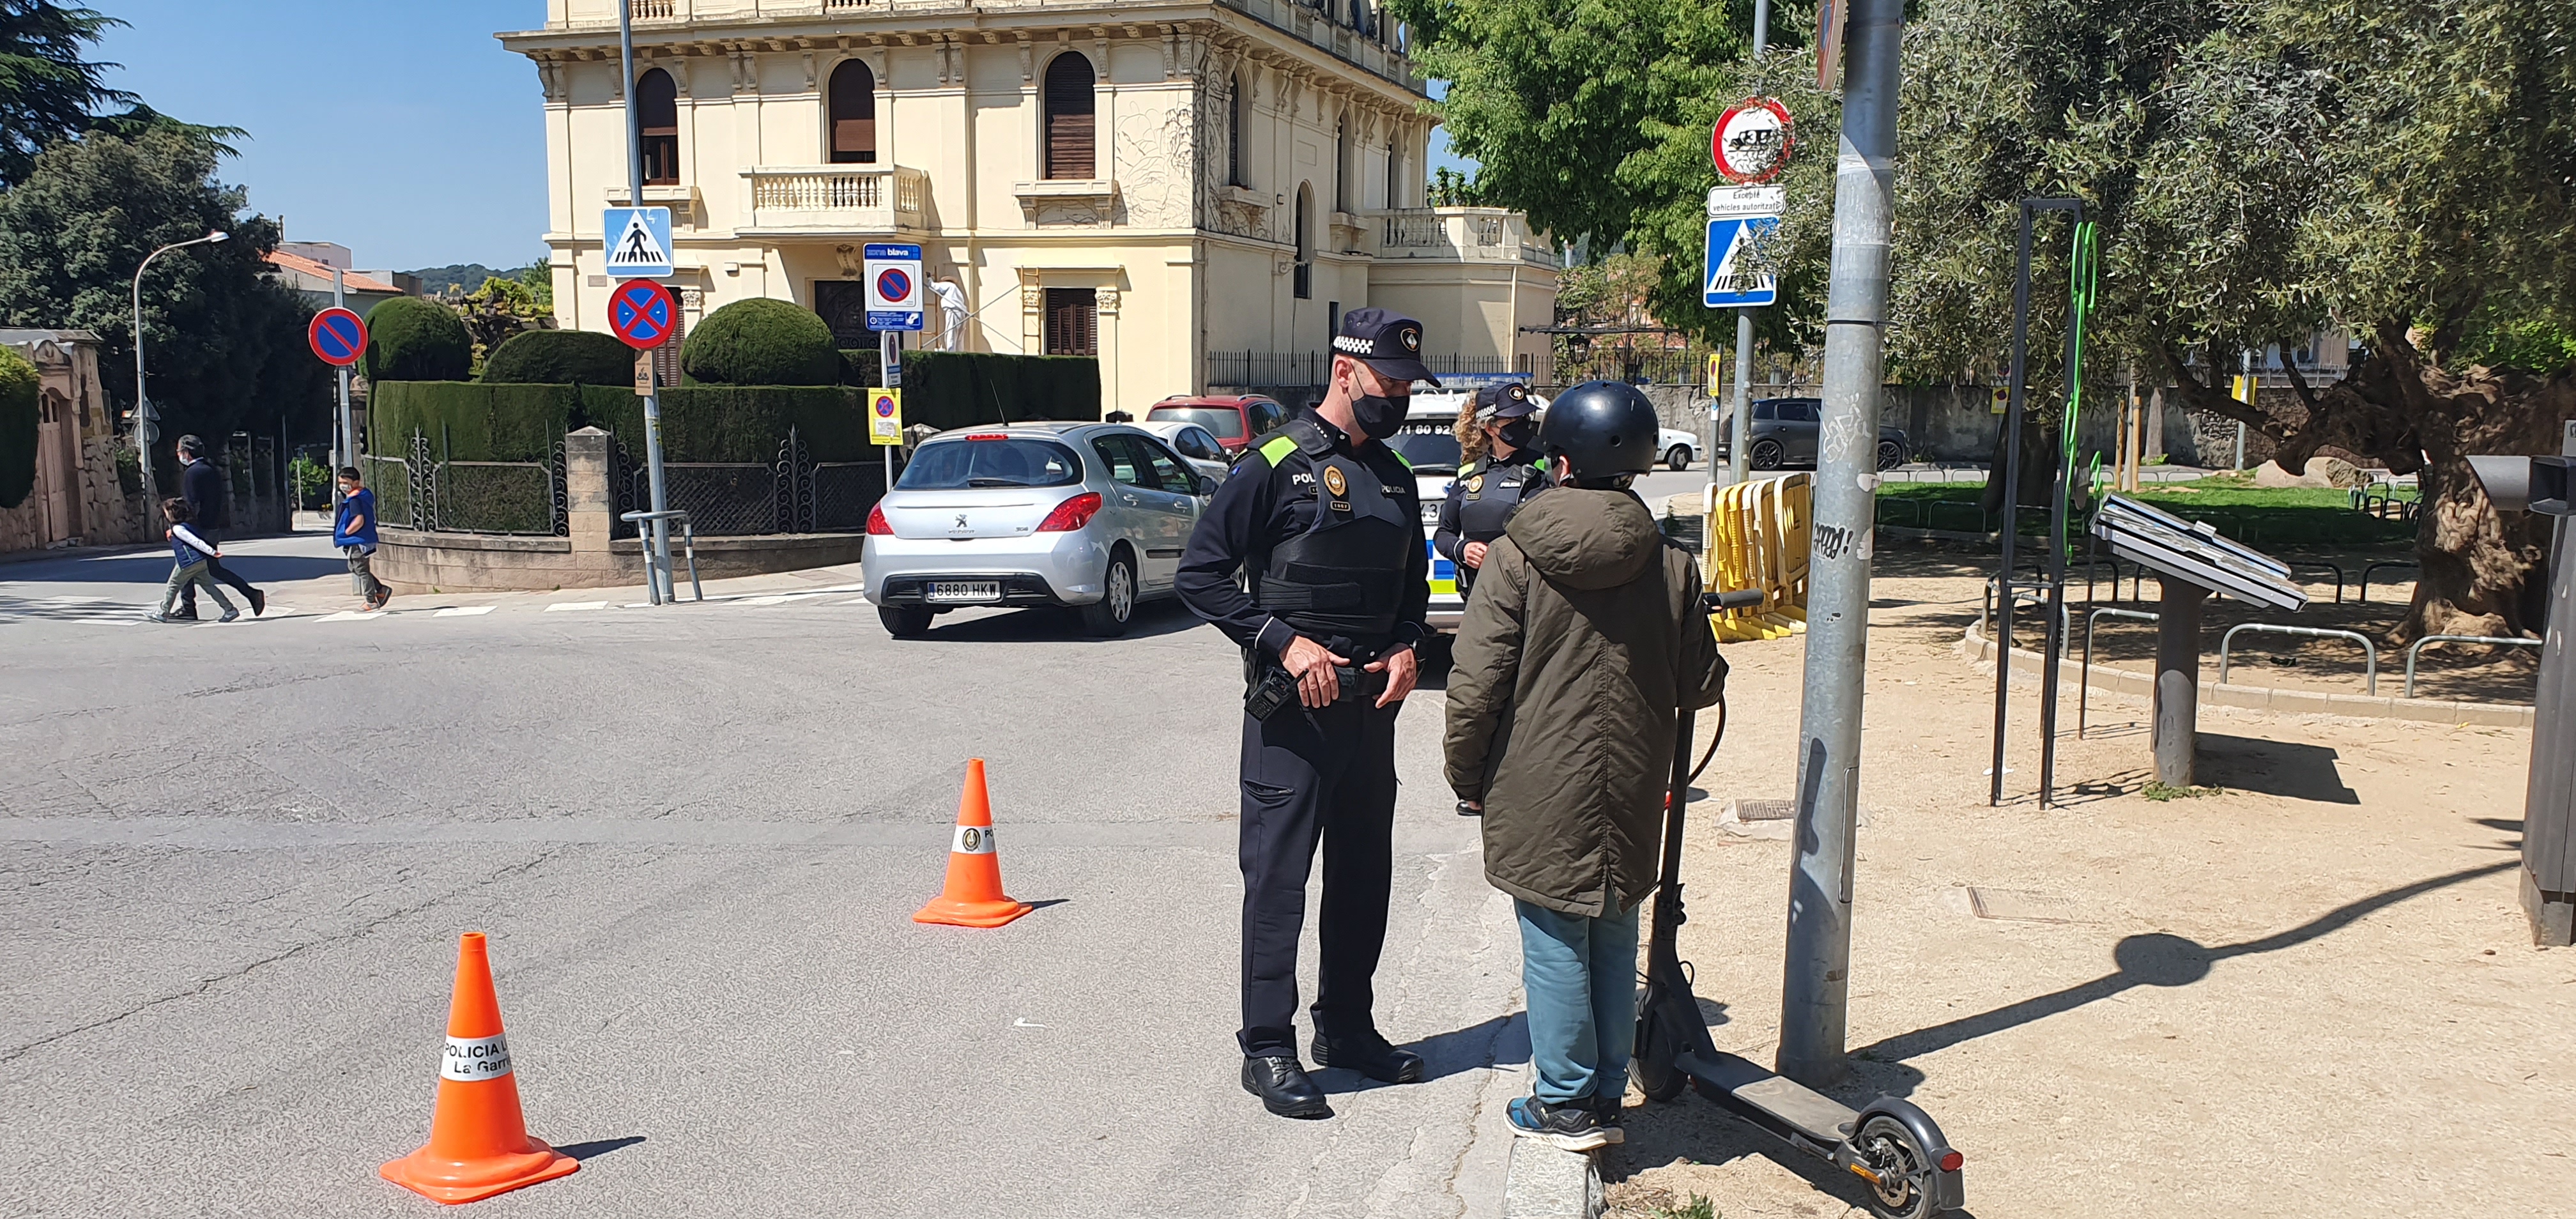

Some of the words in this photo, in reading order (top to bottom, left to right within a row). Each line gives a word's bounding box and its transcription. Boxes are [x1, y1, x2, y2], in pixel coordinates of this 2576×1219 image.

[1415, 425, 1431, 435] 80
[1292, 473, 1316, 485] POL
[937, 584, 968, 596] 6880
[972, 583, 996, 596] HKW
[445, 1041, 500, 1059] POLICIA
[454, 1061, 471, 1074] La
